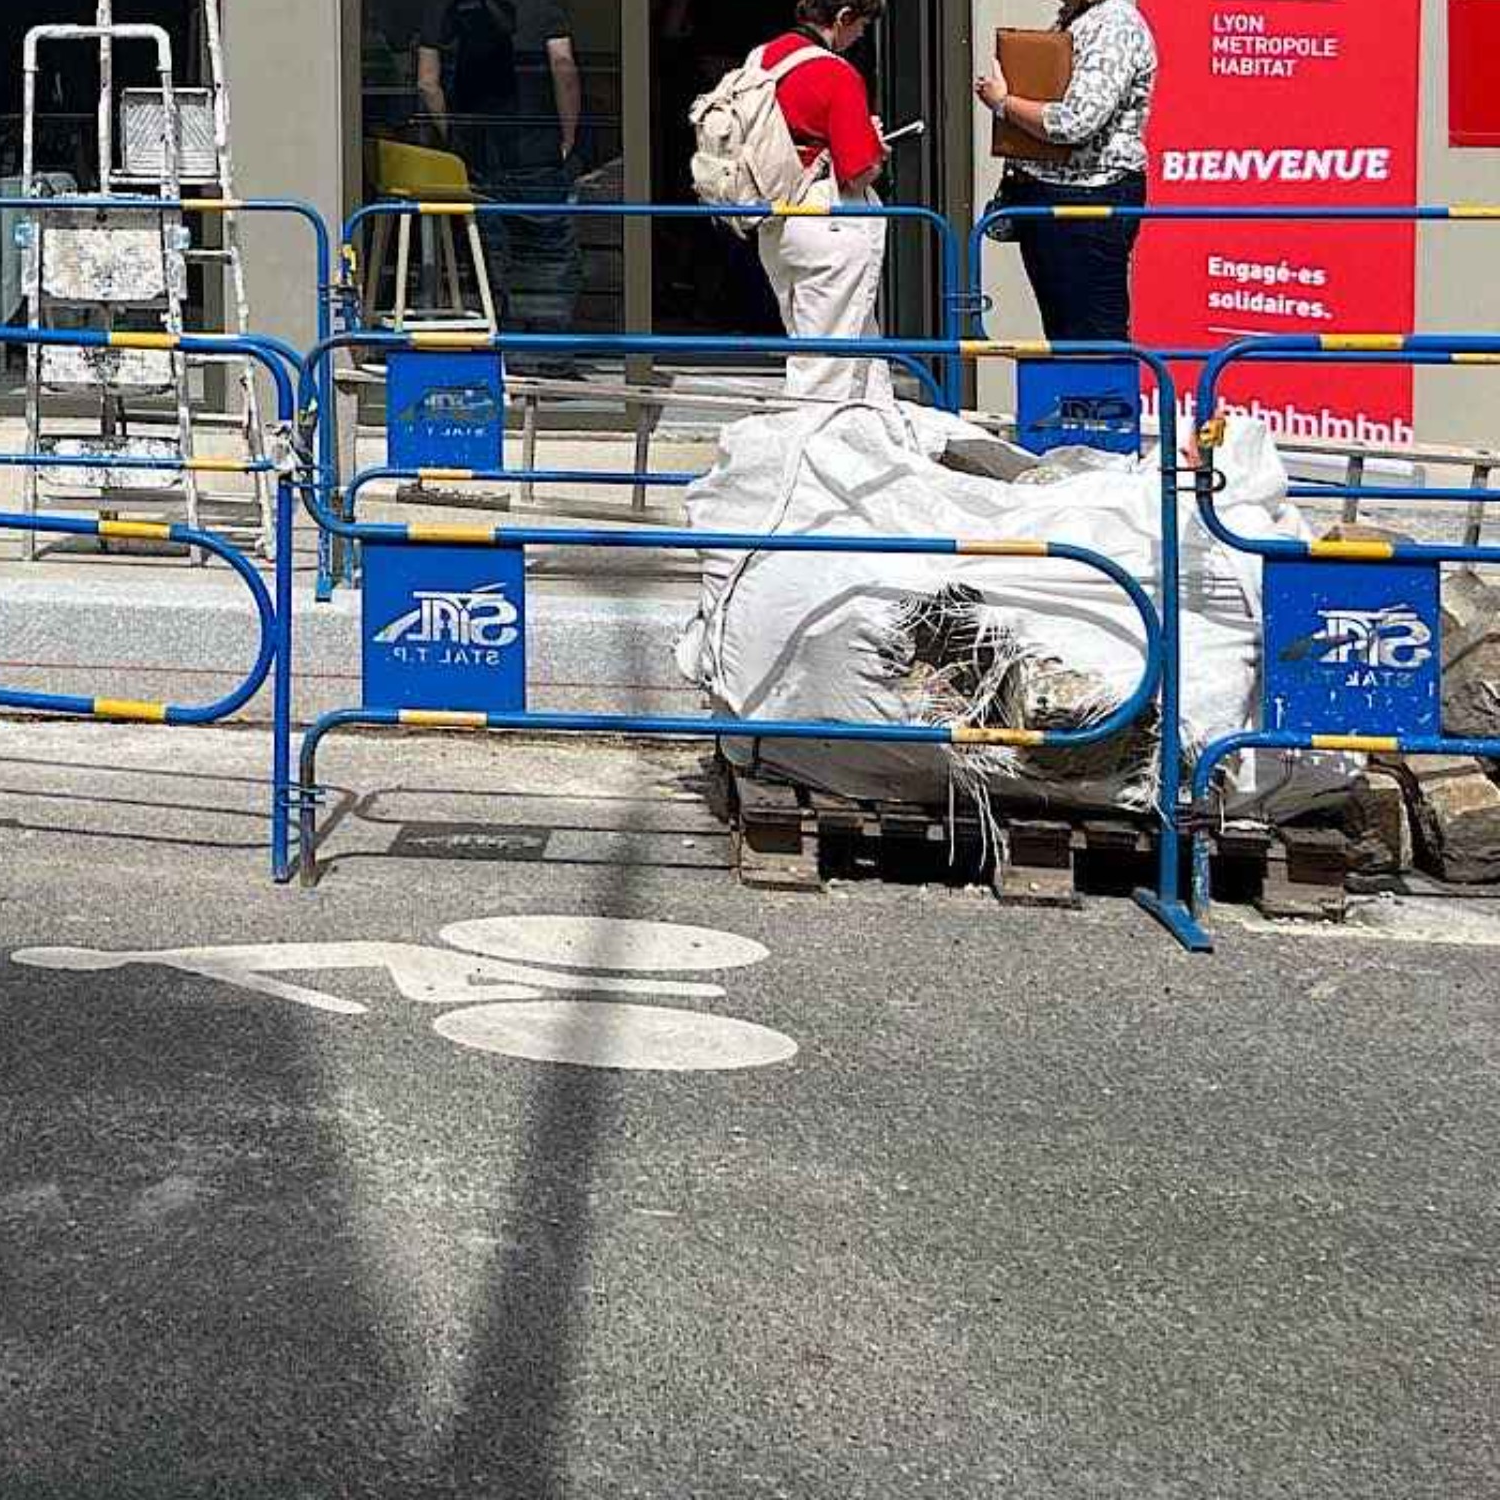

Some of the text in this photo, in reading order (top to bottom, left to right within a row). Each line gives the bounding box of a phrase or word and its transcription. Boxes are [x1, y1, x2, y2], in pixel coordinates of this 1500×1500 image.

[1212, 14, 1264, 33] LYON
[1212, 36, 1339, 57] METROPOLE
[1212, 57, 1296, 77] HABITAT
[1162, 148, 1390, 182] BIENVENUE
[1208, 290, 1333, 319] solidaires.
